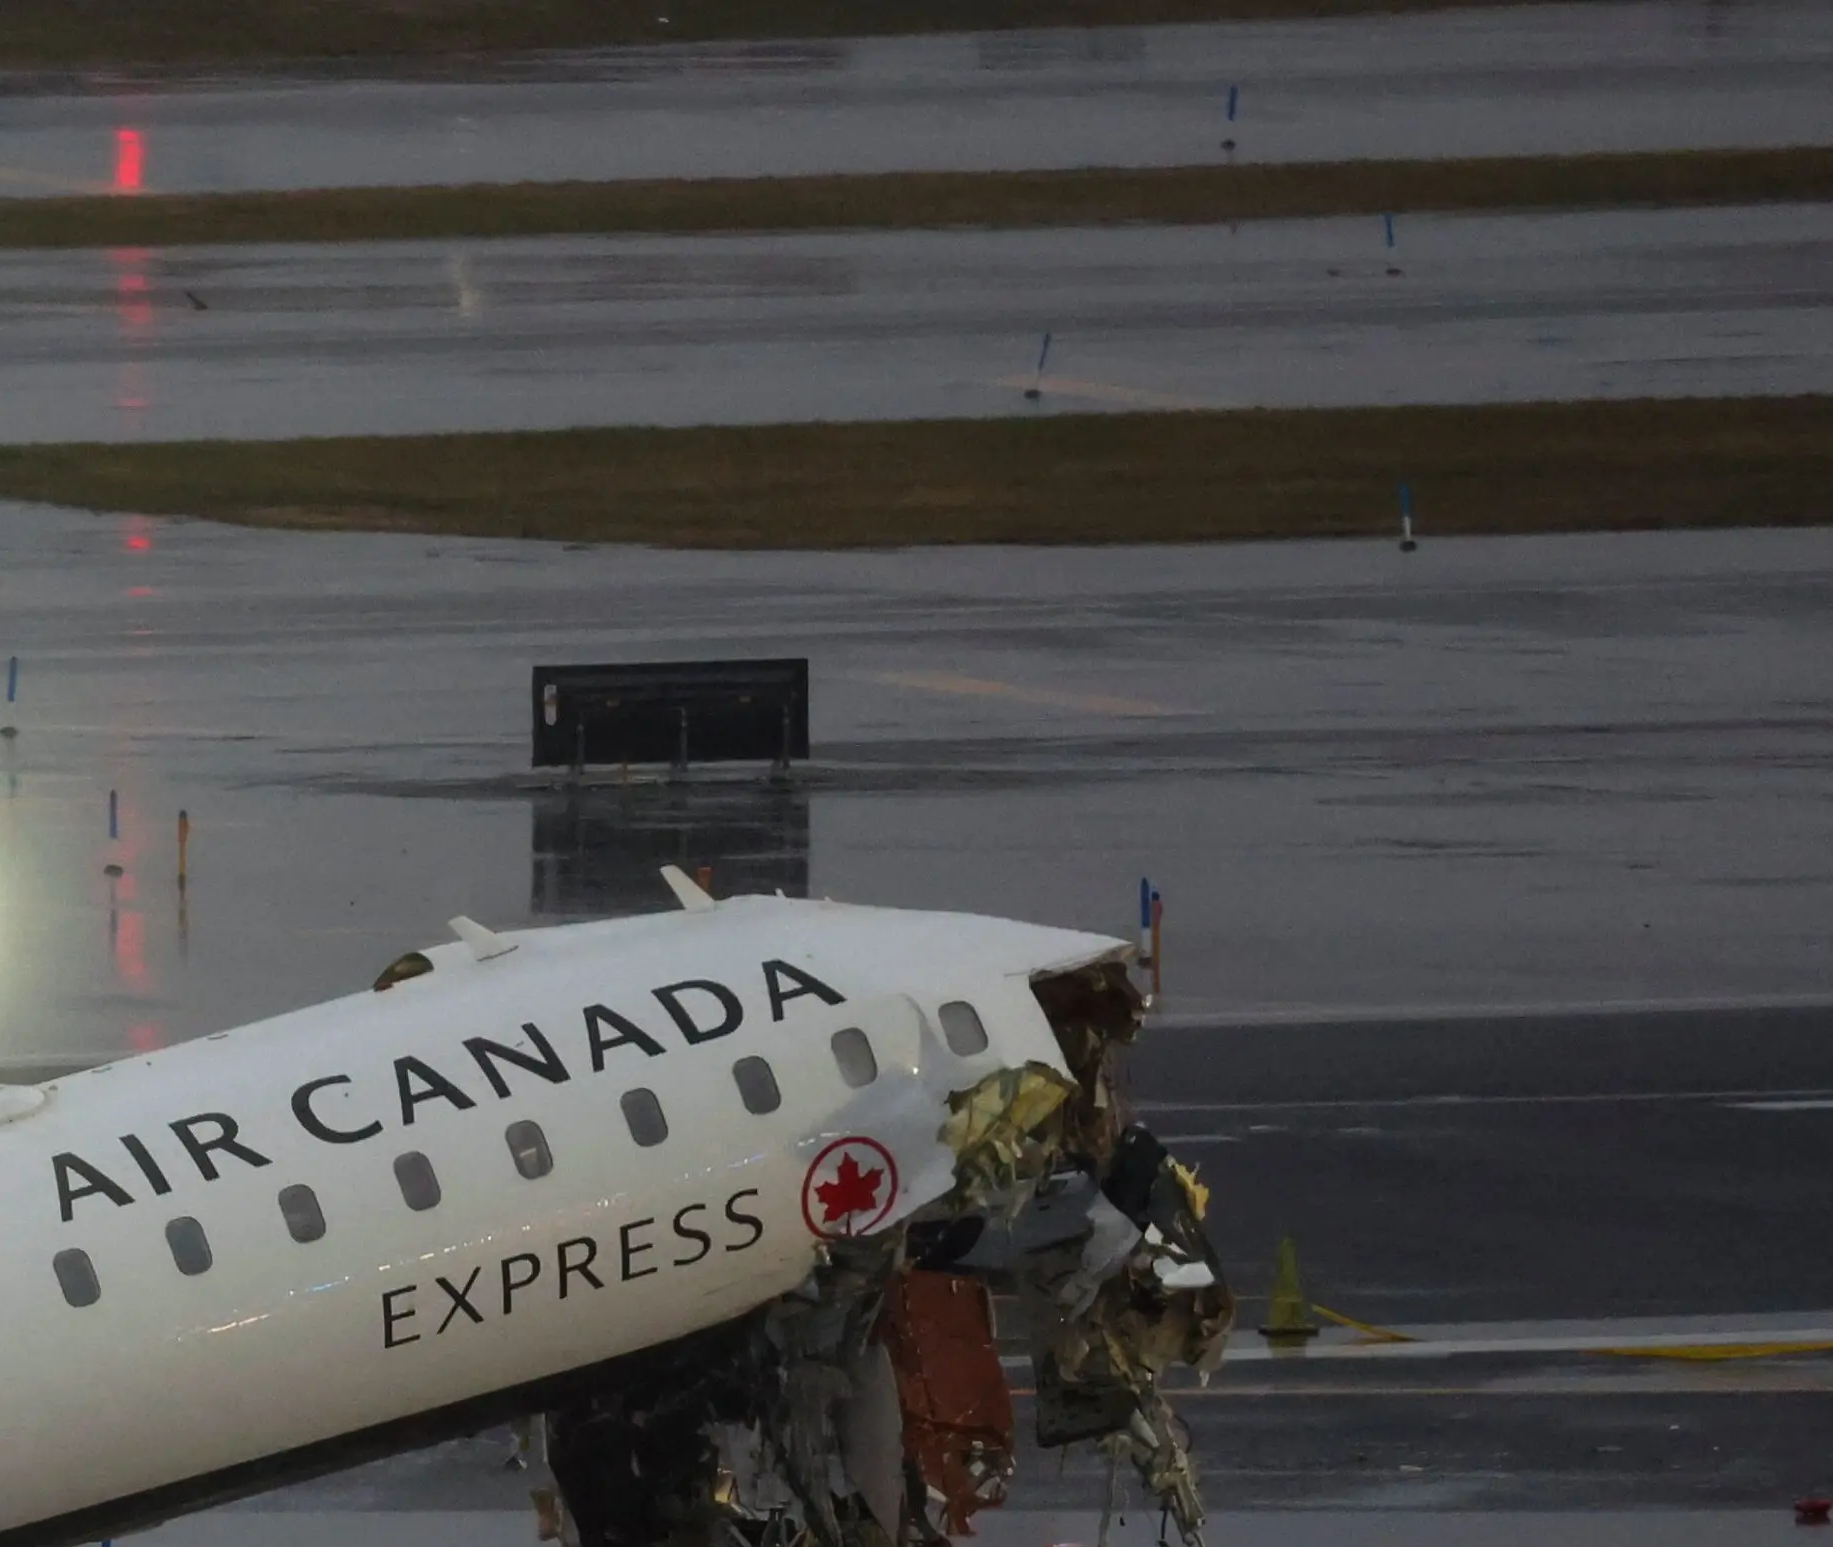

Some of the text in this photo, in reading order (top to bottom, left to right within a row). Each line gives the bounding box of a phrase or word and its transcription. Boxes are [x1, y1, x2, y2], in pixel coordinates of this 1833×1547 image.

[49, 959, 846, 1222] AIR CANADA
[381, 1189, 764, 1350] EXPRESS
